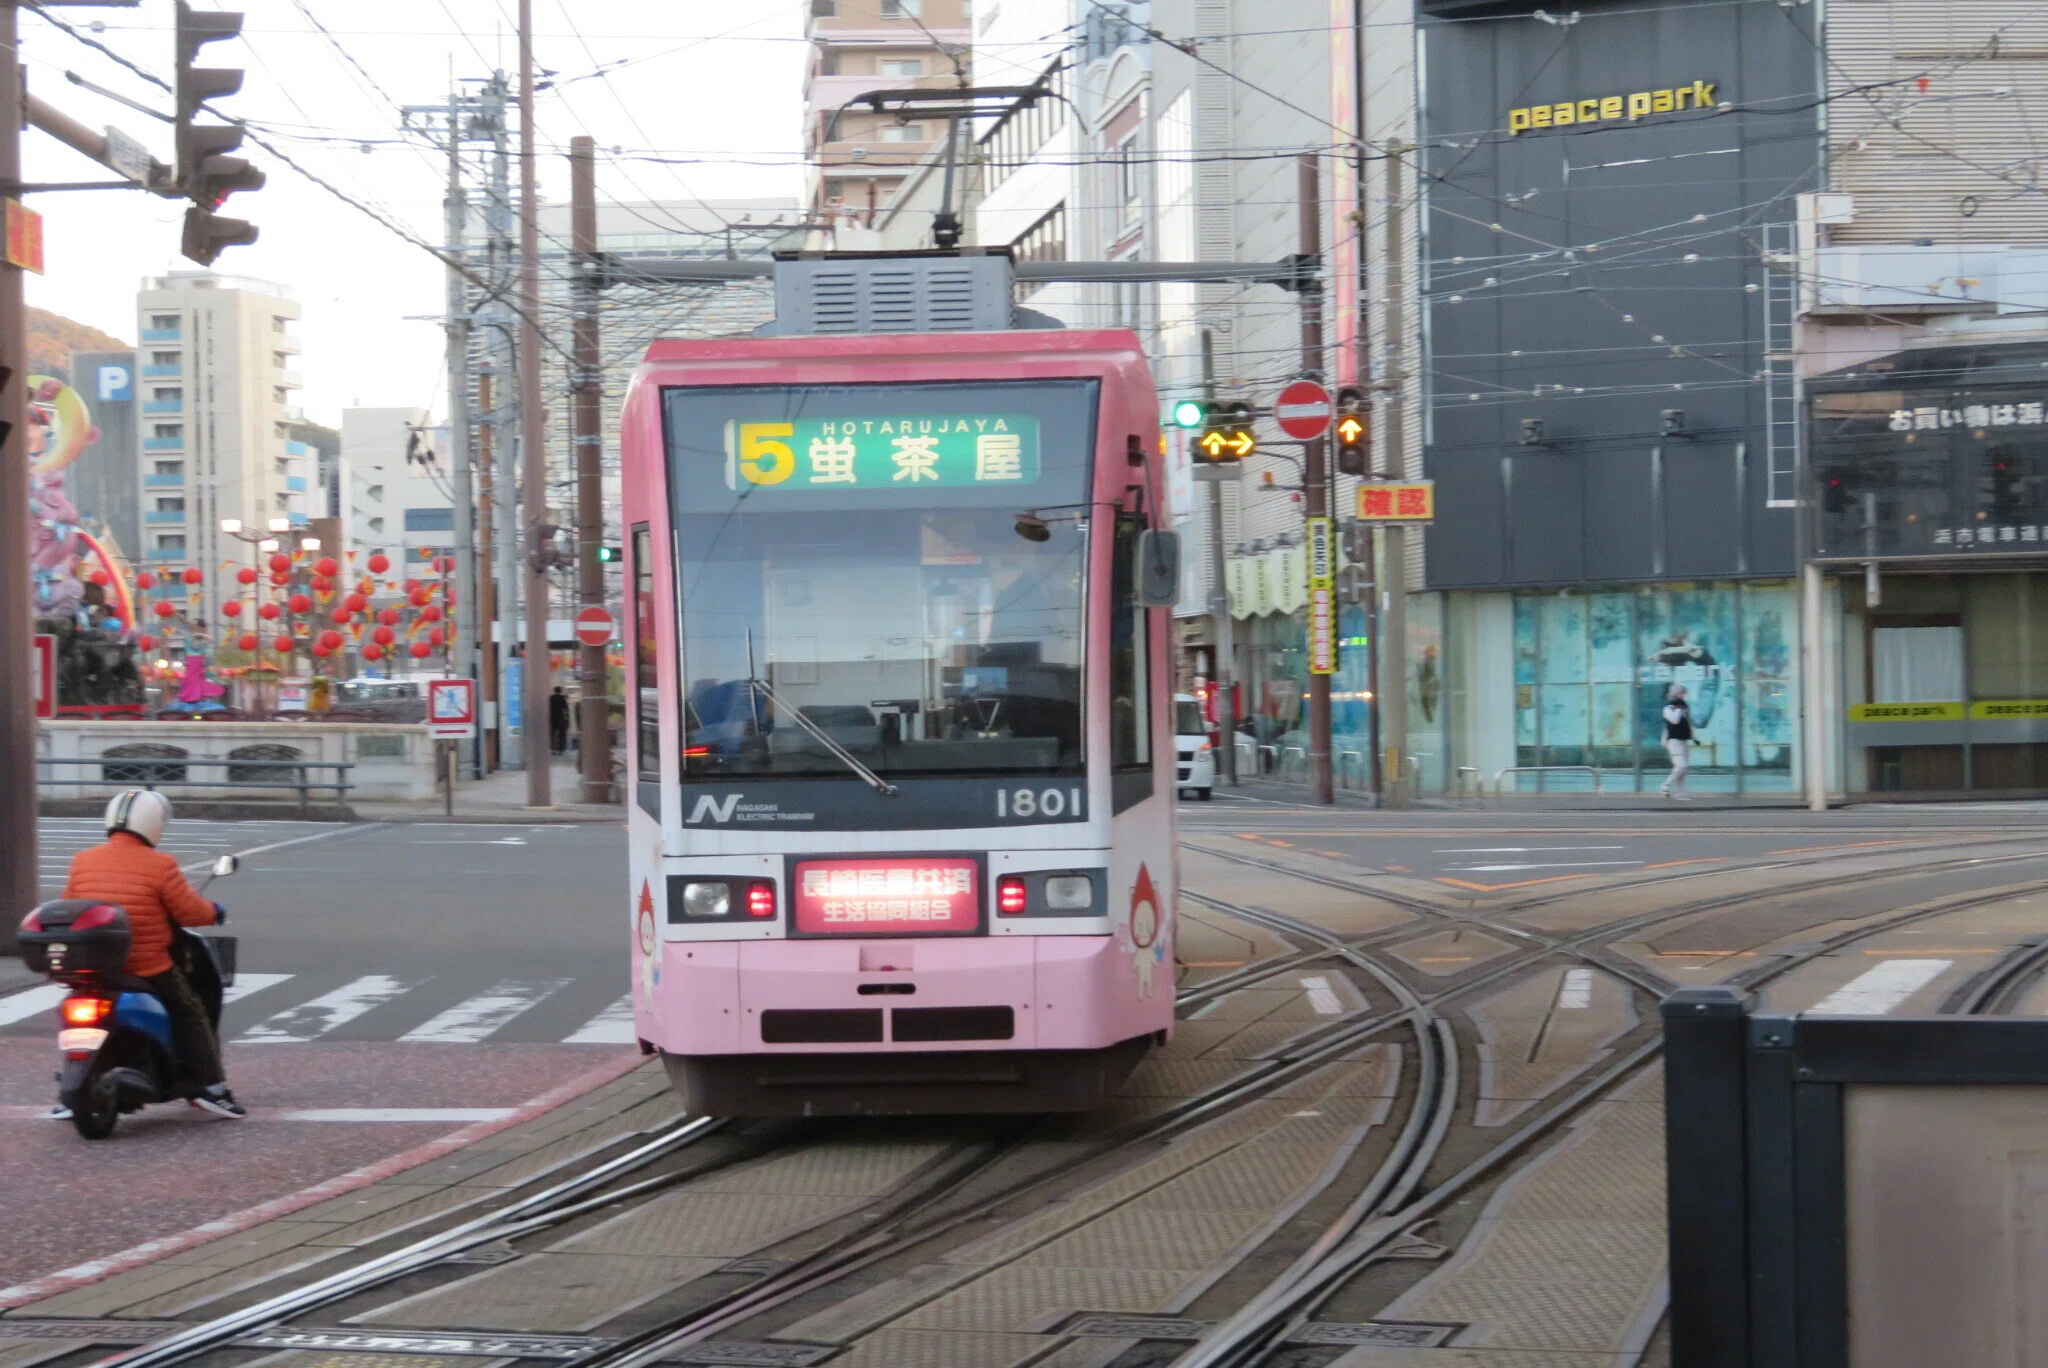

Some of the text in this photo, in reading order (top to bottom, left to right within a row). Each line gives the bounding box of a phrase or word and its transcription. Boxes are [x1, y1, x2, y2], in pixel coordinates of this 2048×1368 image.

[1509, 80, 1717, 136] peace park
[99, 366, 128, 399] P
[822, 418, 1009, 436] HOTARUJAYA
[1888, 402, 2048, 431] お買い物は浜
[739, 422, 796, 486] 5
[809, 433, 1024, 484] 蛍茶屋
[1363, 488, 1428, 516] 確認
[736, 804, 778, 812] NAGASAKI
[736, 813, 776, 821] ELECTRIC
[997, 788, 1081, 817] 1801
